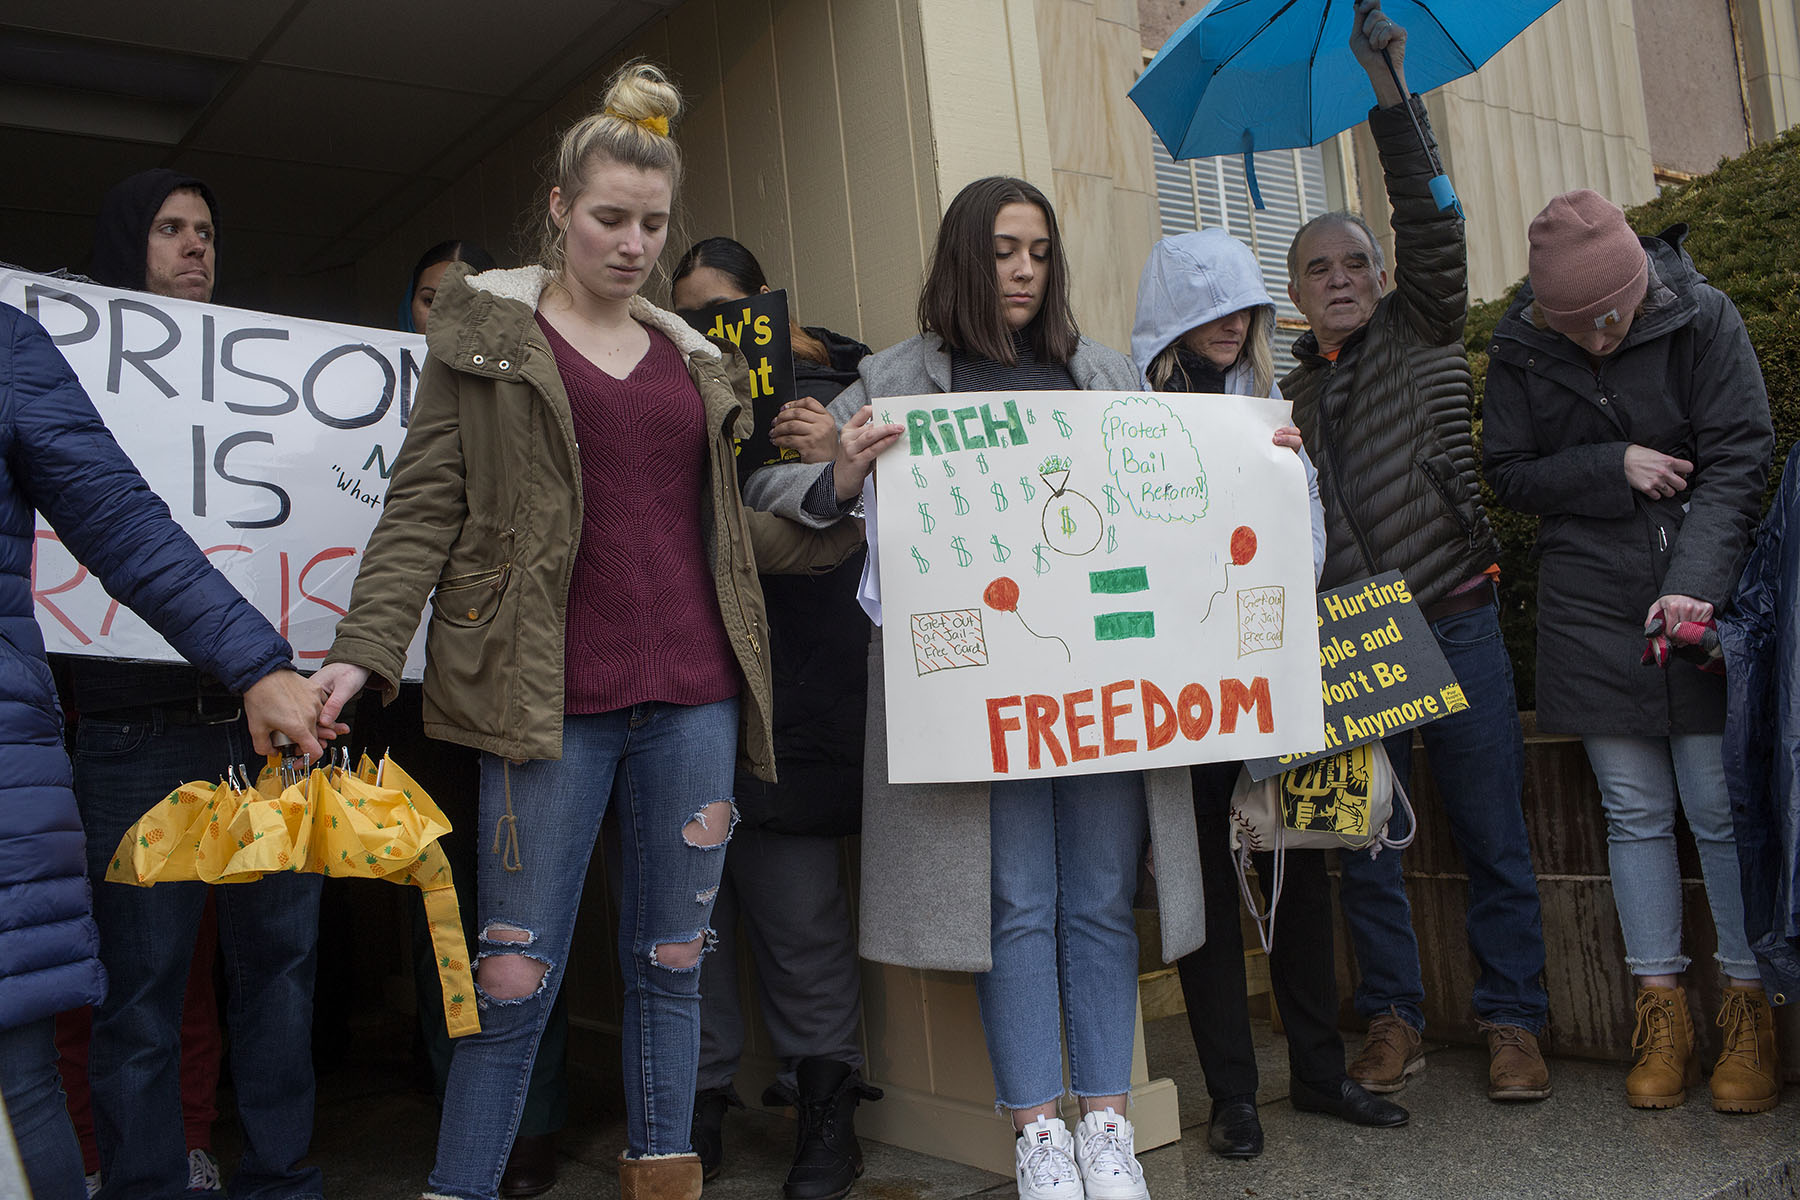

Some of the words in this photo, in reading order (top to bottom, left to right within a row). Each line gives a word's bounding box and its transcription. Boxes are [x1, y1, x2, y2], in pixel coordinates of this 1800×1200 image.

[1110, 416, 1168, 440] Protect
[1122, 447, 1166, 473] Bail
[192, 424, 291, 529] IS
[1142, 476, 1204, 502] Reform!
[1324, 579, 1412, 622] Hurting
[919, 617, 946, 631] Get
[1361, 617, 1403, 652] and
[925, 647, 948, 659] Free
[954, 643, 979, 655] Card
[1372, 662, 1408, 688] Be
[985, 676, 1274, 774] FREEDOM
[1343, 694, 1439, 742] Anymore
